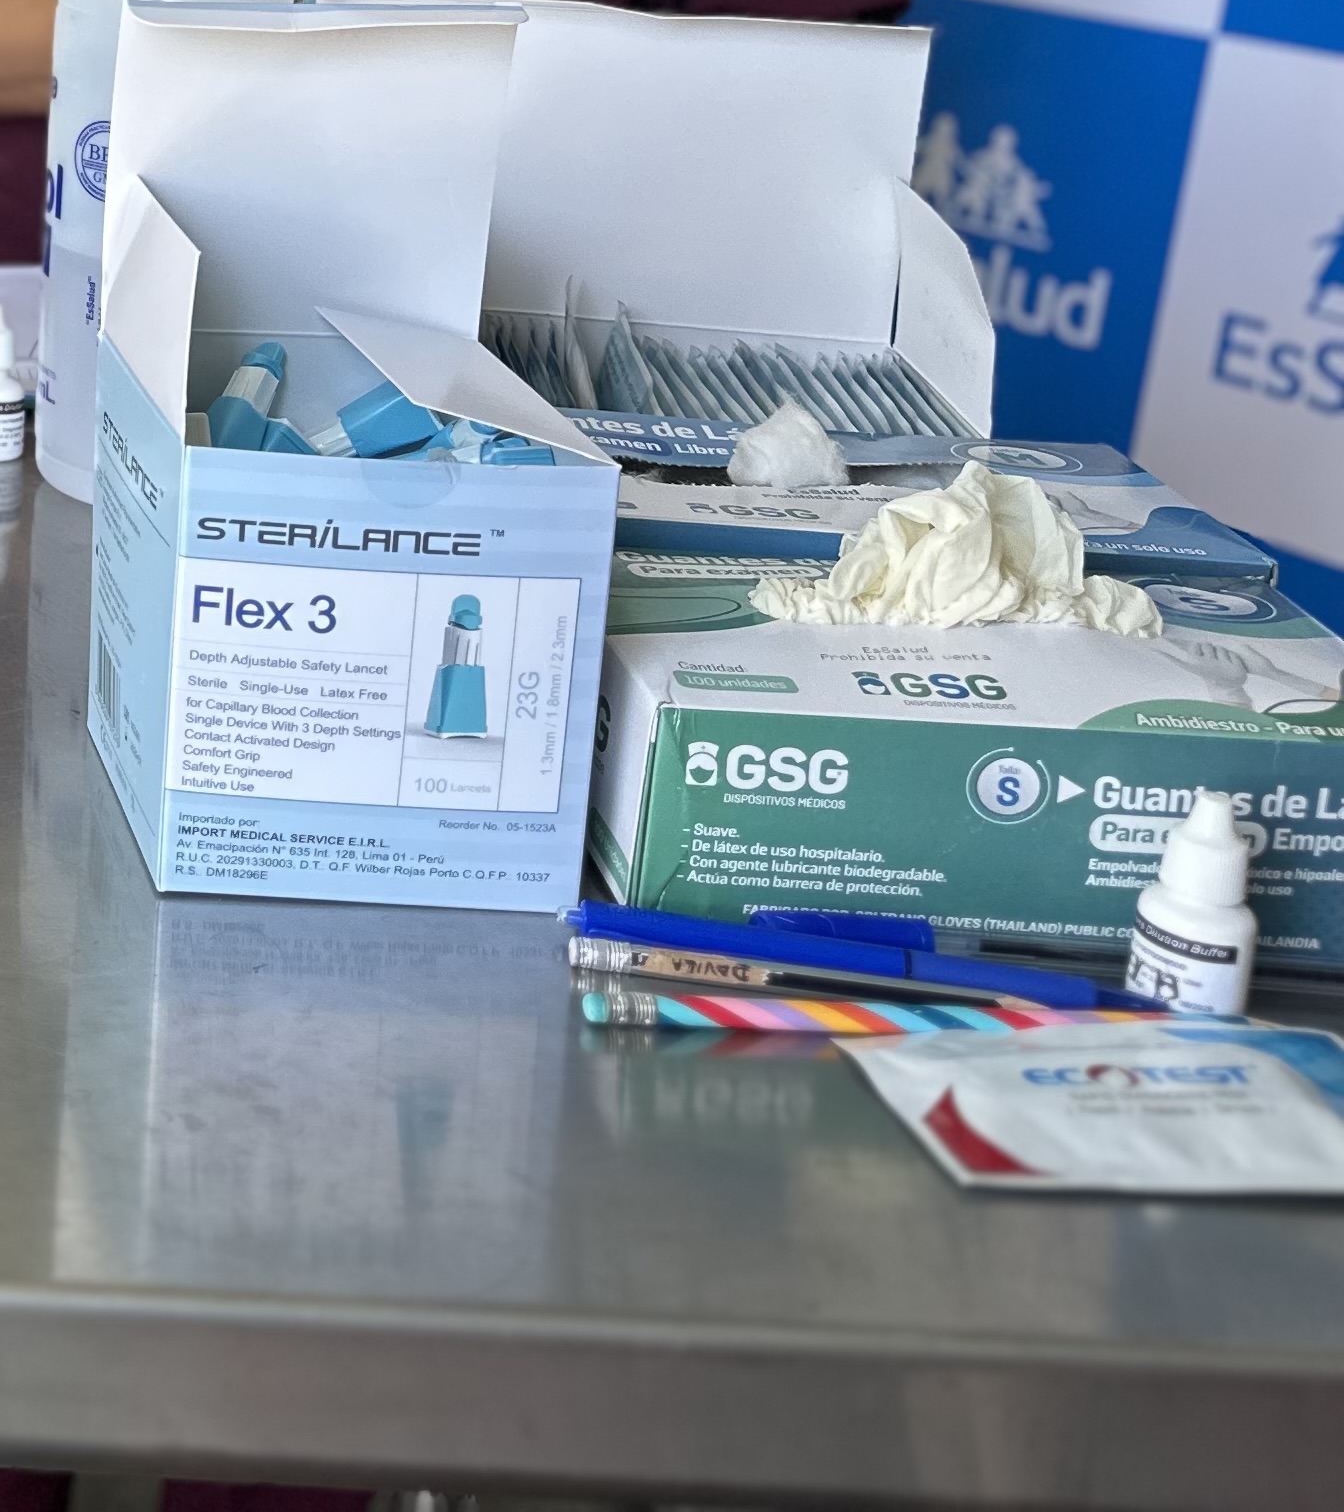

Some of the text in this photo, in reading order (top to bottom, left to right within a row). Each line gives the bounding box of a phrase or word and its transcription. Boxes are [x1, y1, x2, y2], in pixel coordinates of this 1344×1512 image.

[650, 421, 699, 439] de
[674, 442, 729, 456] Libre
[718, 504, 821, 520] GSG
[615, 550, 788, 567] Guantes
[1131, 543, 1171, 553] solo
[1173, 546, 1208, 557] uso
[641, 565, 811, 577] Para examen
[191, 584, 338, 634] Flex 3
[189, 649, 388, 675] Depth Adjustable Safety Lancet
[820, 653, 992, 662] Prohibida su venta
[187, 675, 388, 701] Sterile Single-Use Latex Free
[685, 675, 789, 690] 100 unidades
[889, 672, 1009, 702] GSG
[515, 671, 540, 720] 23G
[186, 696, 359, 721] for Capillary Blood Collection
[185, 712, 402, 740] Single Device With 3 Depth Settings
[1136, 713, 1259, 733] Ambidiestro
[1275, 721, 1325, 737] Para
[184, 728, 335, 752] Contact Activated Design
[183, 744, 261, 763] Comfort Grip
[182, 759, 293, 780] Safety Engineered
[725, 744, 849, 795] GSG
[181, 776, 255, 792] Intuitive Use
[415, 777, 448, 794] 100
[996, 776, 1021, 807] S
[797, 797, 846, 810] MÉDICOS
[1093, 775, 1309, 819] Guans de
[178, 812, 235, 826] Importado
[439, 819, 481, 831] Reorder
[506, 822, 557, 833] 05-1523A
[177, 825, 227, 838] IMPORT
[230, 829, 287, 842] MEDICAL
[290, 833, 345, 846] SERVICE
[694, 823, 740, 838] Suave.
[1100, 821, 1155, 844] Para
[289, 846, 311, 857] 635
[362, 851, 389, 862] Lima
[393, 852, 406, 862] 01
[418, 854, 445, 865] Perú
[692, 839, 885, 863] De látex de uso hospitalario.
[355, 863, 391, 875] Wilber
[394, 865, 425, 878] Rojas
[429, 867, 459, 879] Porto
[516, 872, 550, 882] 10337
[689, 855, 947, 883] Con agente lubricante biodegradable.
[687, 870, 923, 897] Actúa como barrera de protección.
[928, 915, 1114, 937] GLOVES (THAILAND) PUBLIC
[1145, 924, 1189, 951] Dilution
[1190, 943, 1231, 960] Buffer
[672, 958, 752, 982] DAVILA
